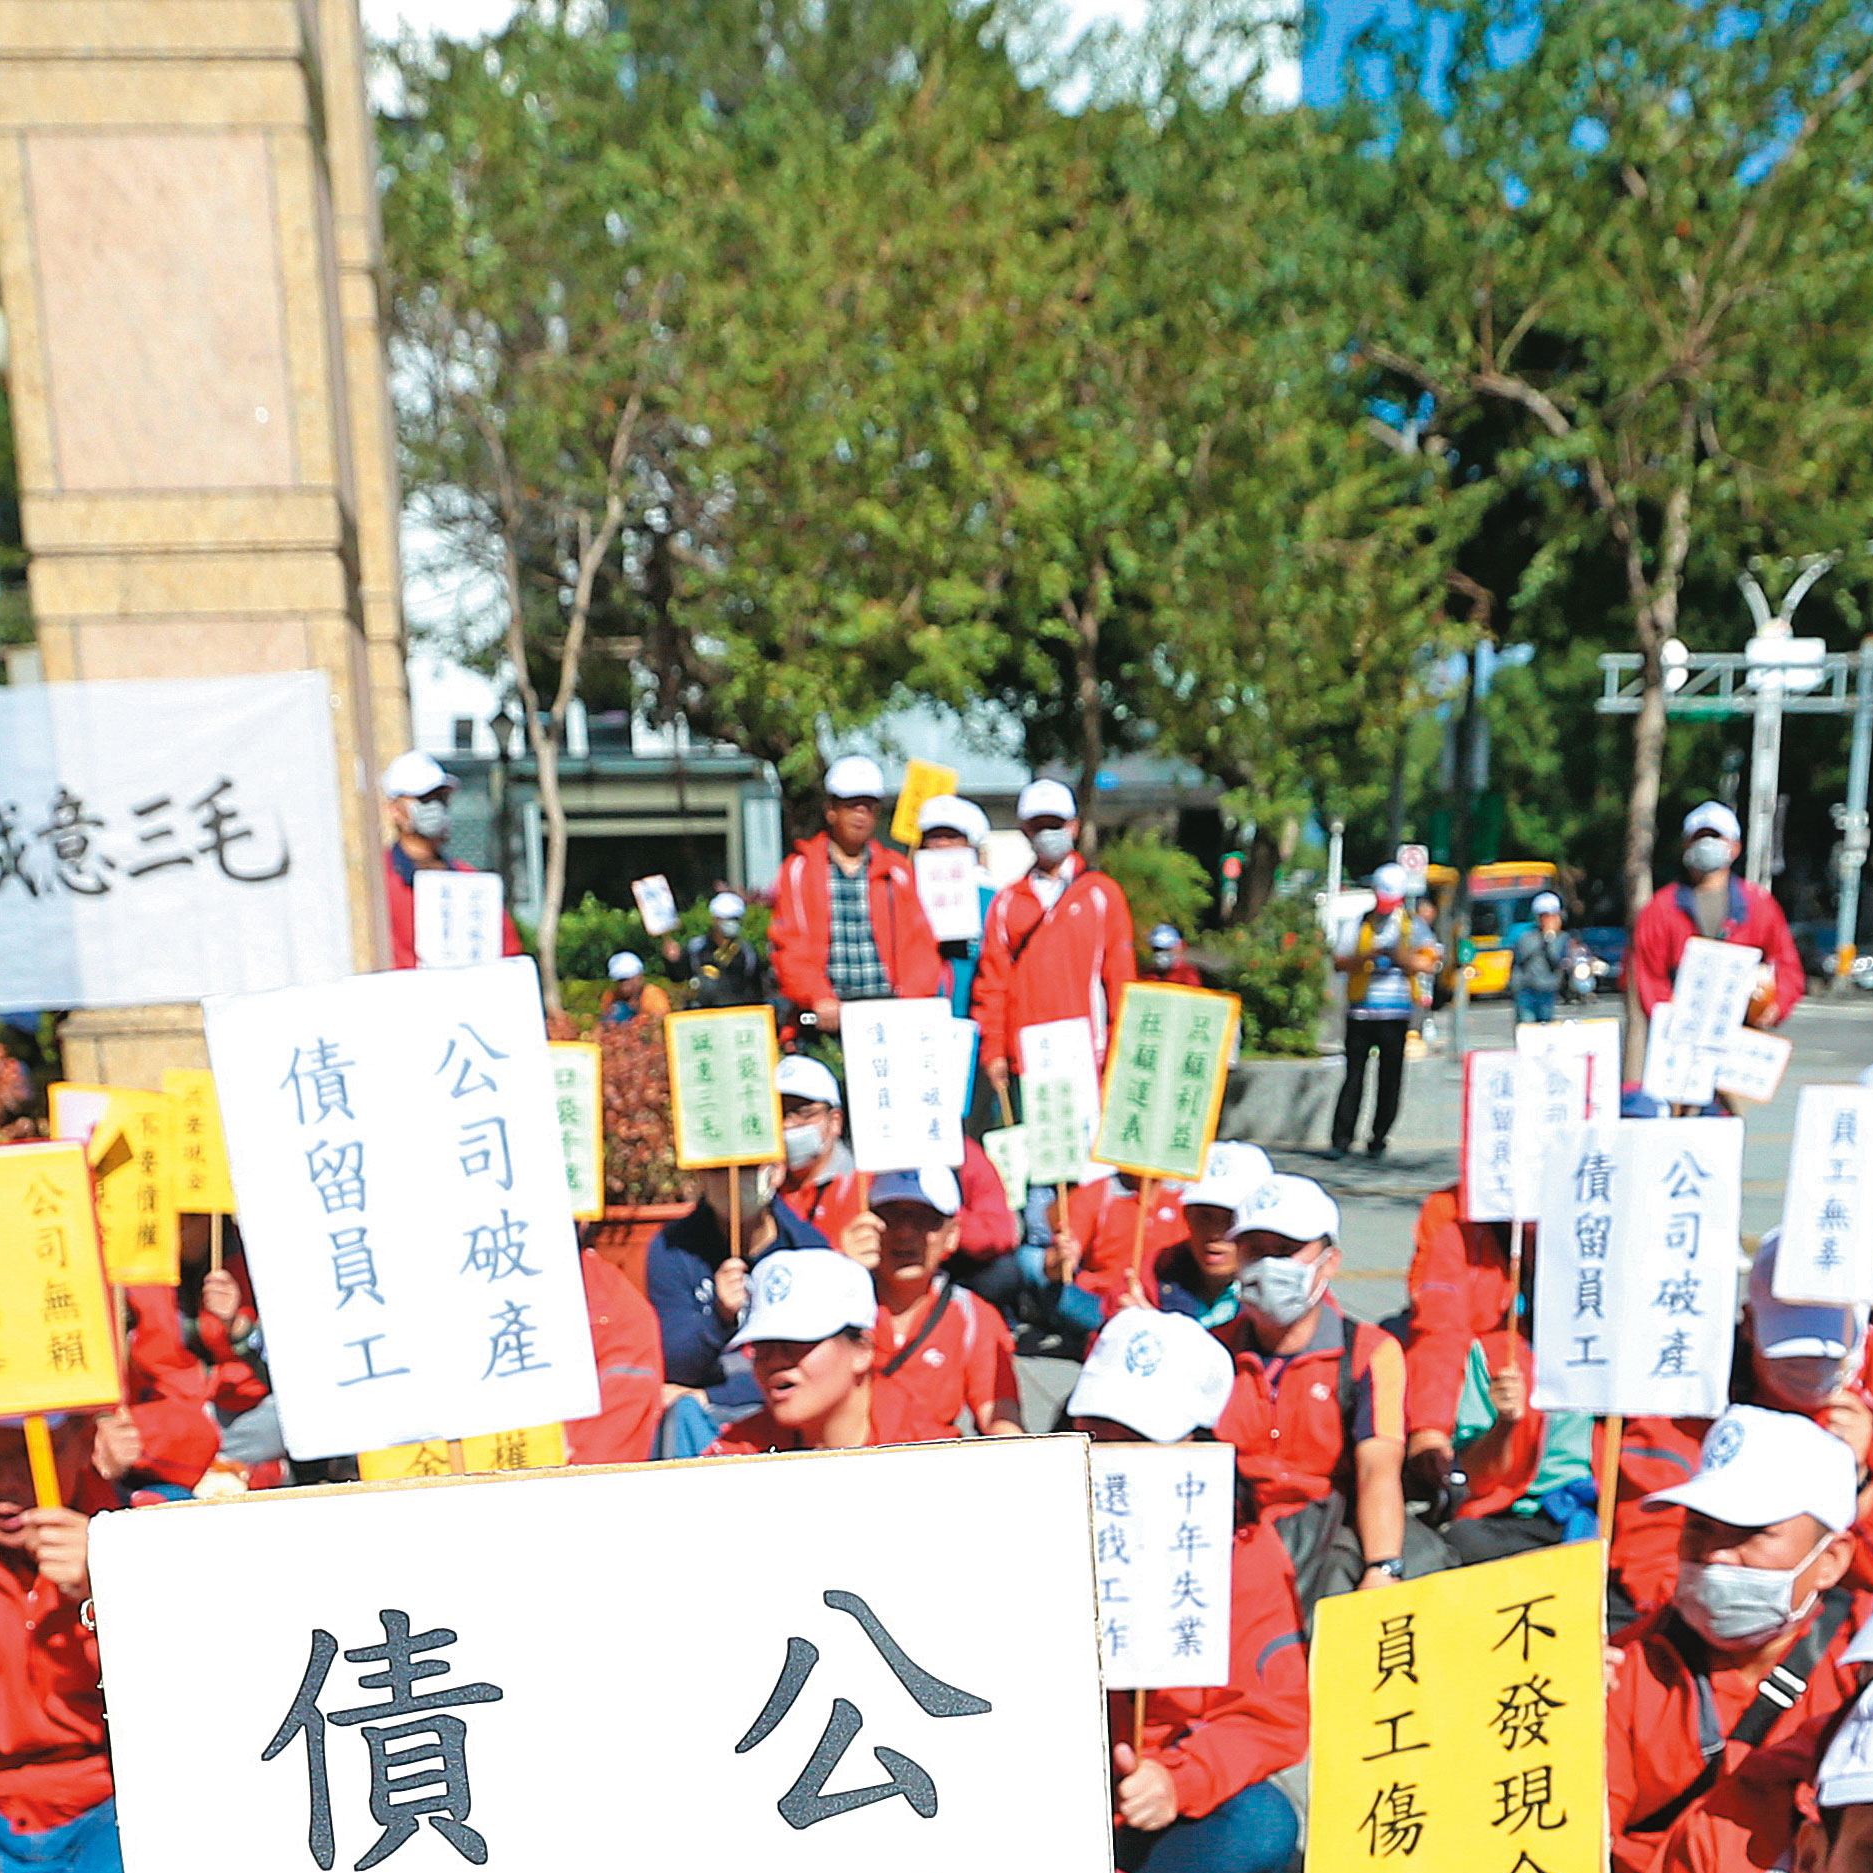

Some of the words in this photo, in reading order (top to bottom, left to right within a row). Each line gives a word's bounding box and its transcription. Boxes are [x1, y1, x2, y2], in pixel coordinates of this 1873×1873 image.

[22, 1171, 89, 1373] 公司無賴
[278, 1035, 411, 1388] 債留員工
[434, 1021, 553, 1382] 公司破產
[1565, 1150, 1619, 1369] 債留員工
[1648, 1149, 1713, 1380] 公司破產
[1167, 1470, 1213, 1658] 中年失業
